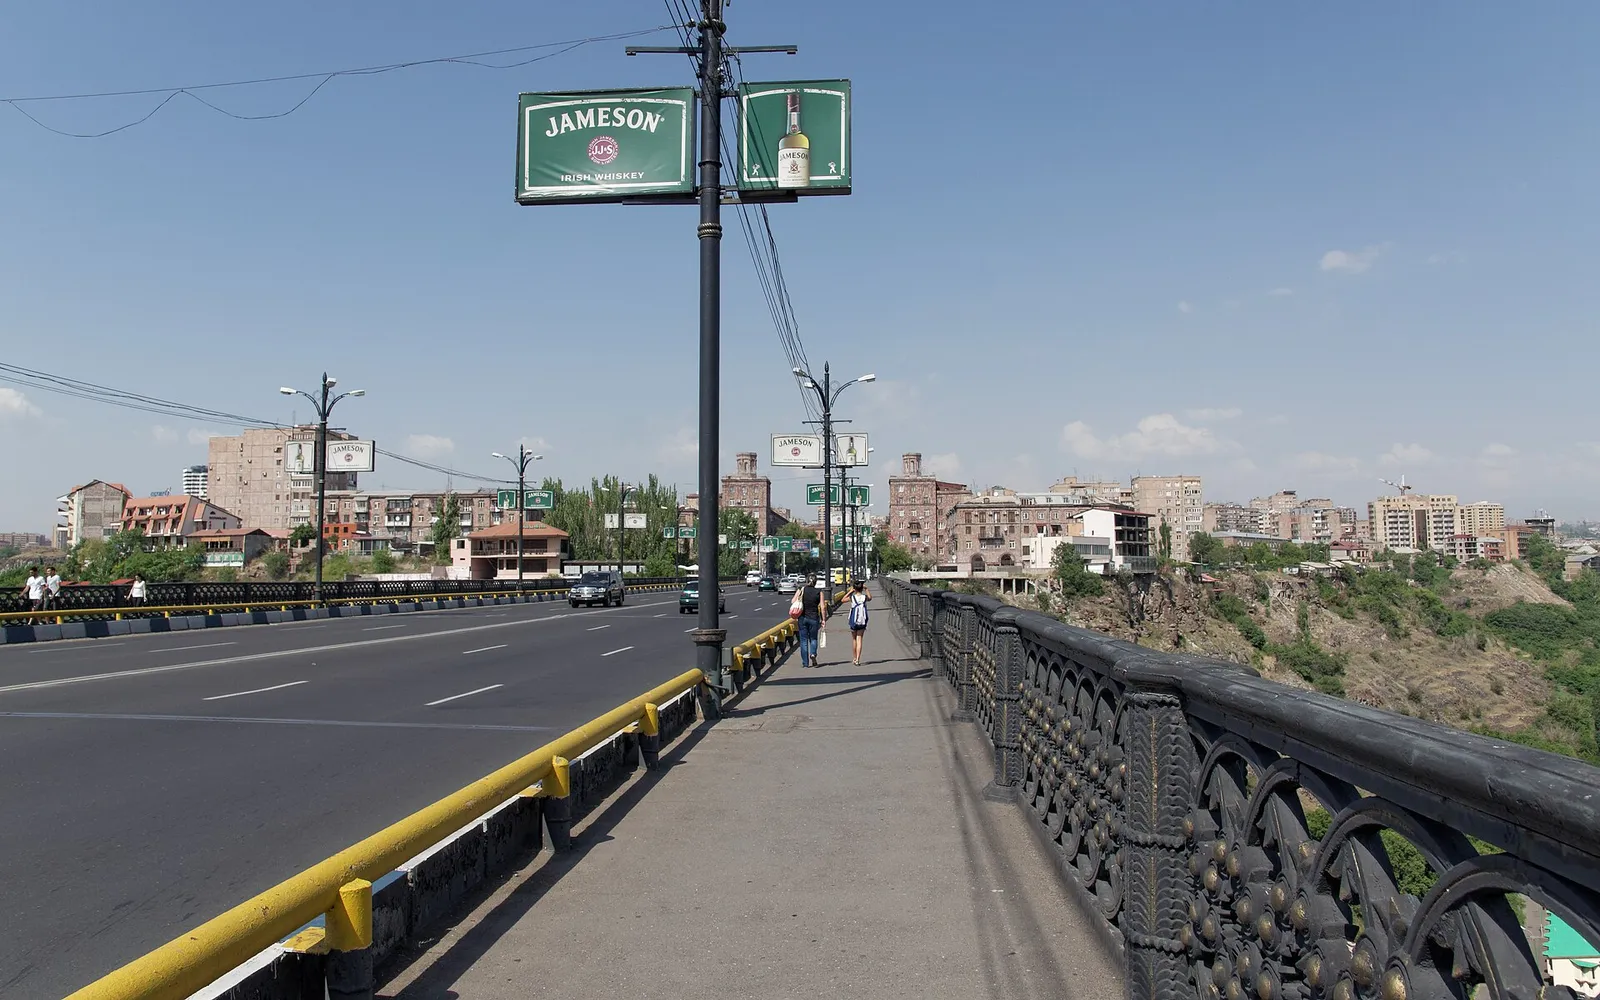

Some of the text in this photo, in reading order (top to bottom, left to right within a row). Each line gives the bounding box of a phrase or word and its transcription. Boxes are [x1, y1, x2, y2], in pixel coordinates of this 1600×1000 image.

[545, 107, 661, 137] JAMESON
[561, 172, 644, 182] IRISH WHISKEY
[779, 438, 813, 447] JAMESON
[333, 445, 364, 454] JAMESON
